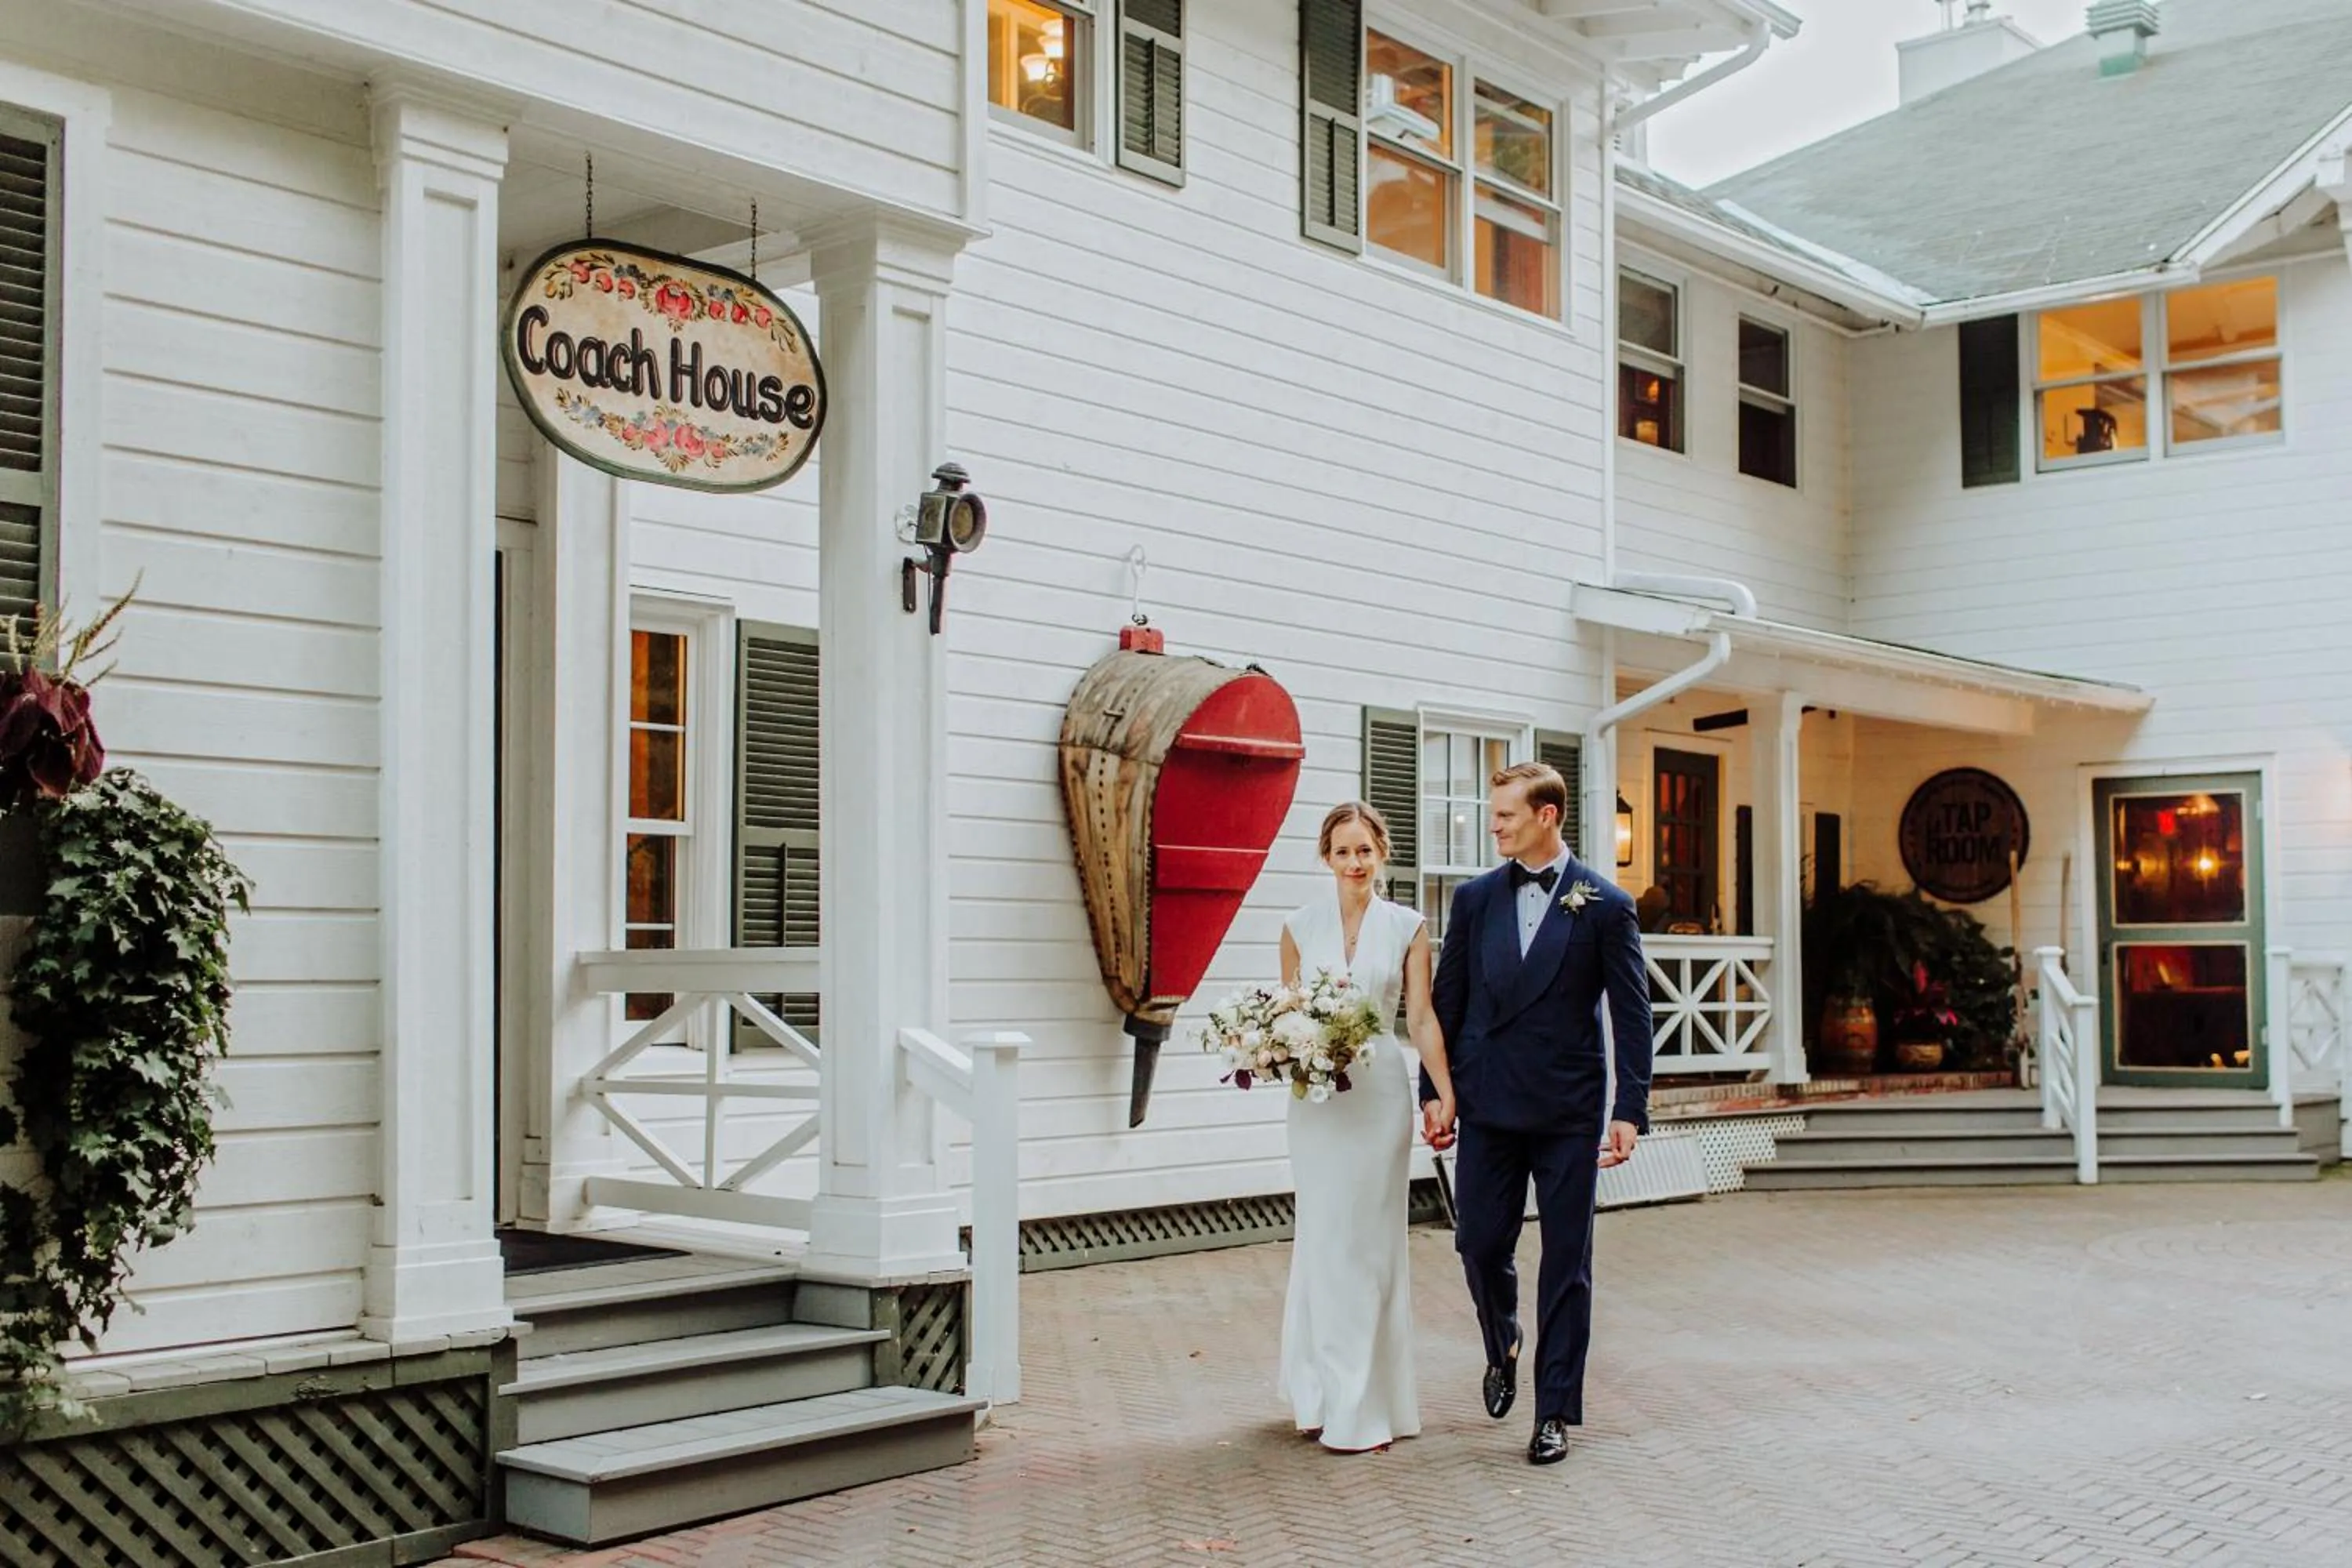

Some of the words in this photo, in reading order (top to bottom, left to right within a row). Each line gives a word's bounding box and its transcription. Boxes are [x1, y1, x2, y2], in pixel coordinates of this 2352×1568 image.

[517, 305, 662, 400] Coach
[670, 337, 816, 430] House
[1941, 800, 1992, 833] TAP
[1926, 835, 2000, 865] ROOM
